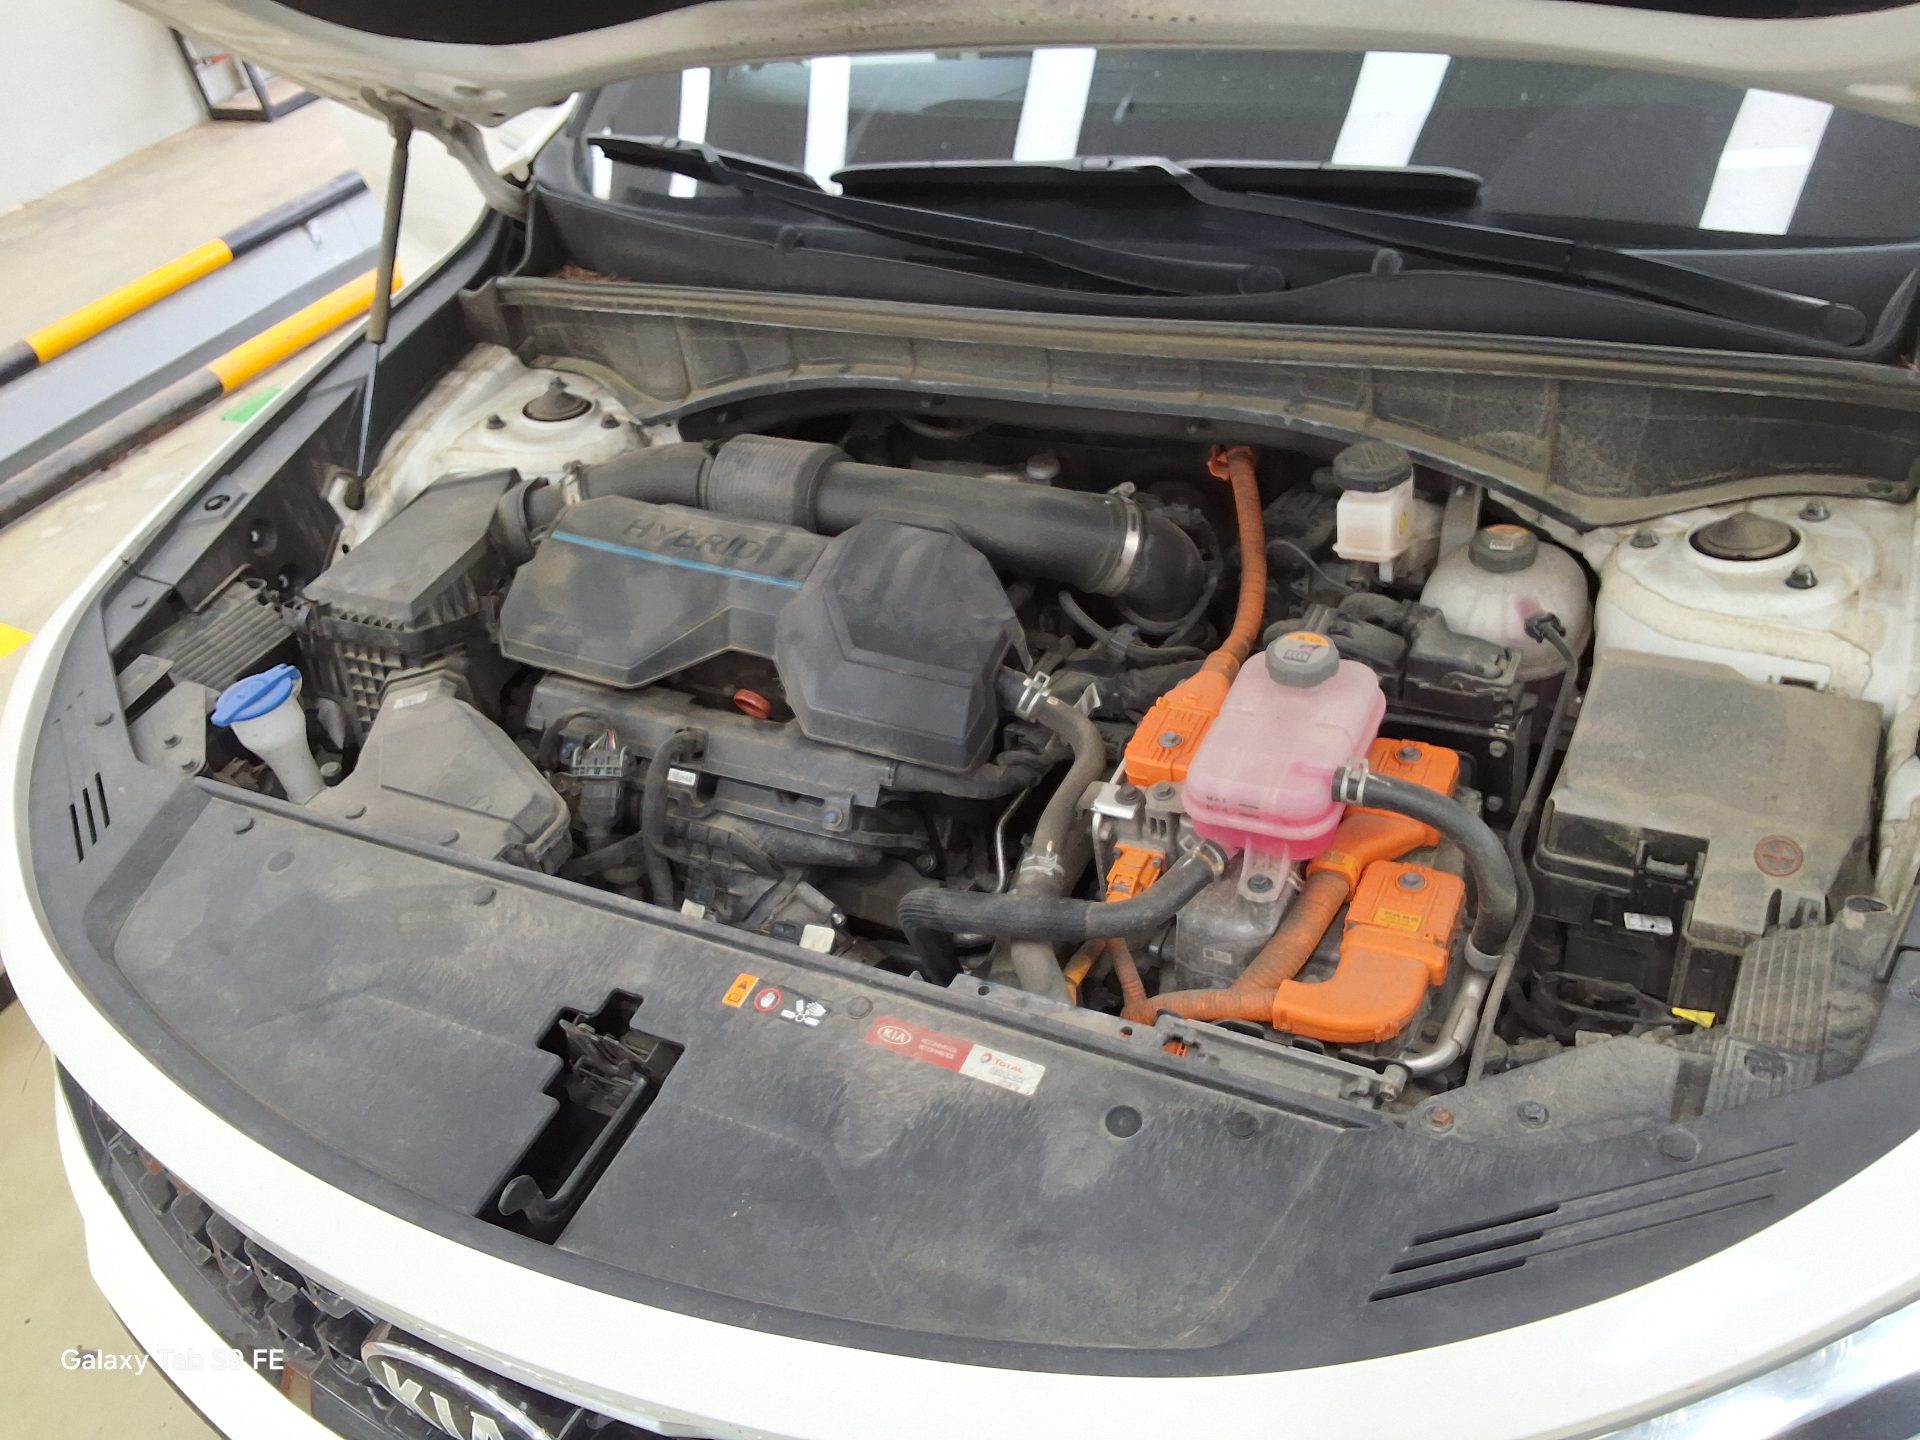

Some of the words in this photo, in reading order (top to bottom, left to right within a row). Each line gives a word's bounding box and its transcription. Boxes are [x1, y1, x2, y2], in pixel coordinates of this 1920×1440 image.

[622, 519, 764, 560] HYBRID
[882, 1027, 907, 1043] KIA
[994, 1057, 1024, 1074] TOTAL
